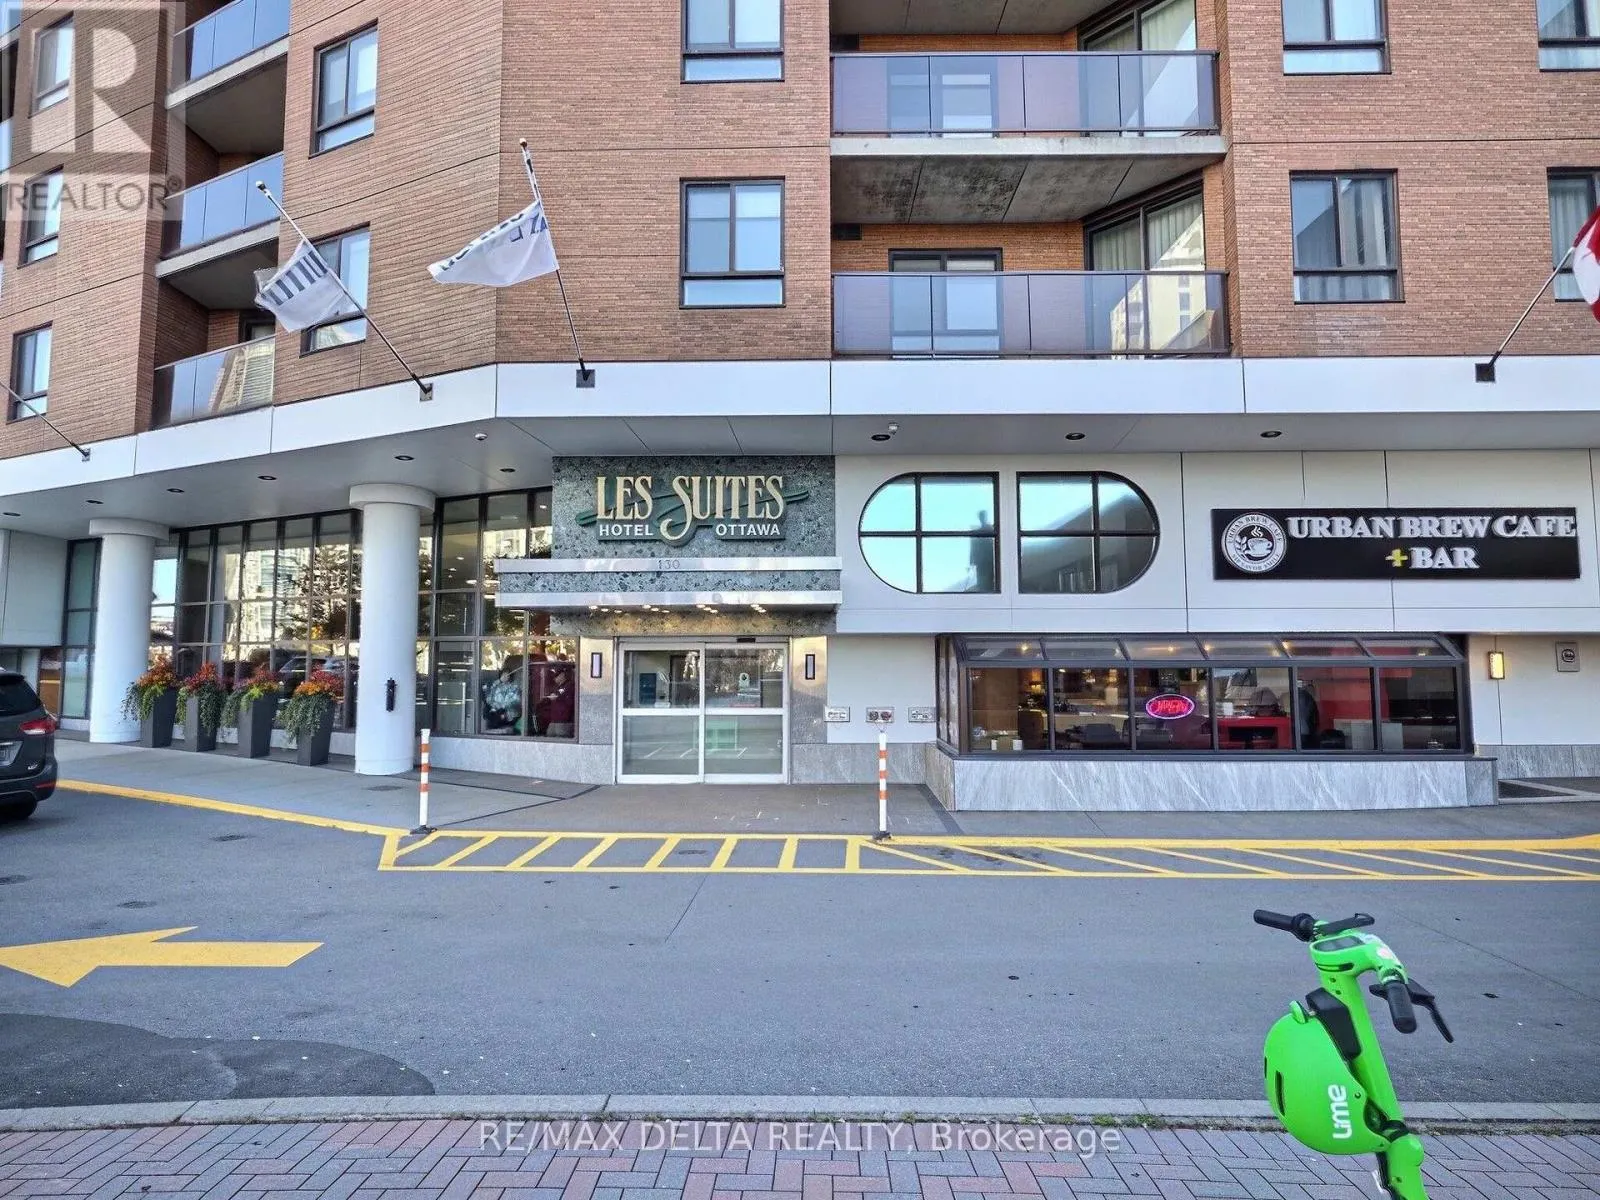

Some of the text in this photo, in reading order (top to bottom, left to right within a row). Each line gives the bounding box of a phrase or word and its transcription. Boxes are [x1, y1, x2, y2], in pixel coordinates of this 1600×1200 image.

[597, 475, 784, 540] LES SUITES
[599, 523, 780, 536] HOTEL OTTAWA
[1286, 515, 1576, 539] URBAN BREW CAFE
[658, 559, 681, 569] 130
[1409, 547, 1480, 569] BAR
